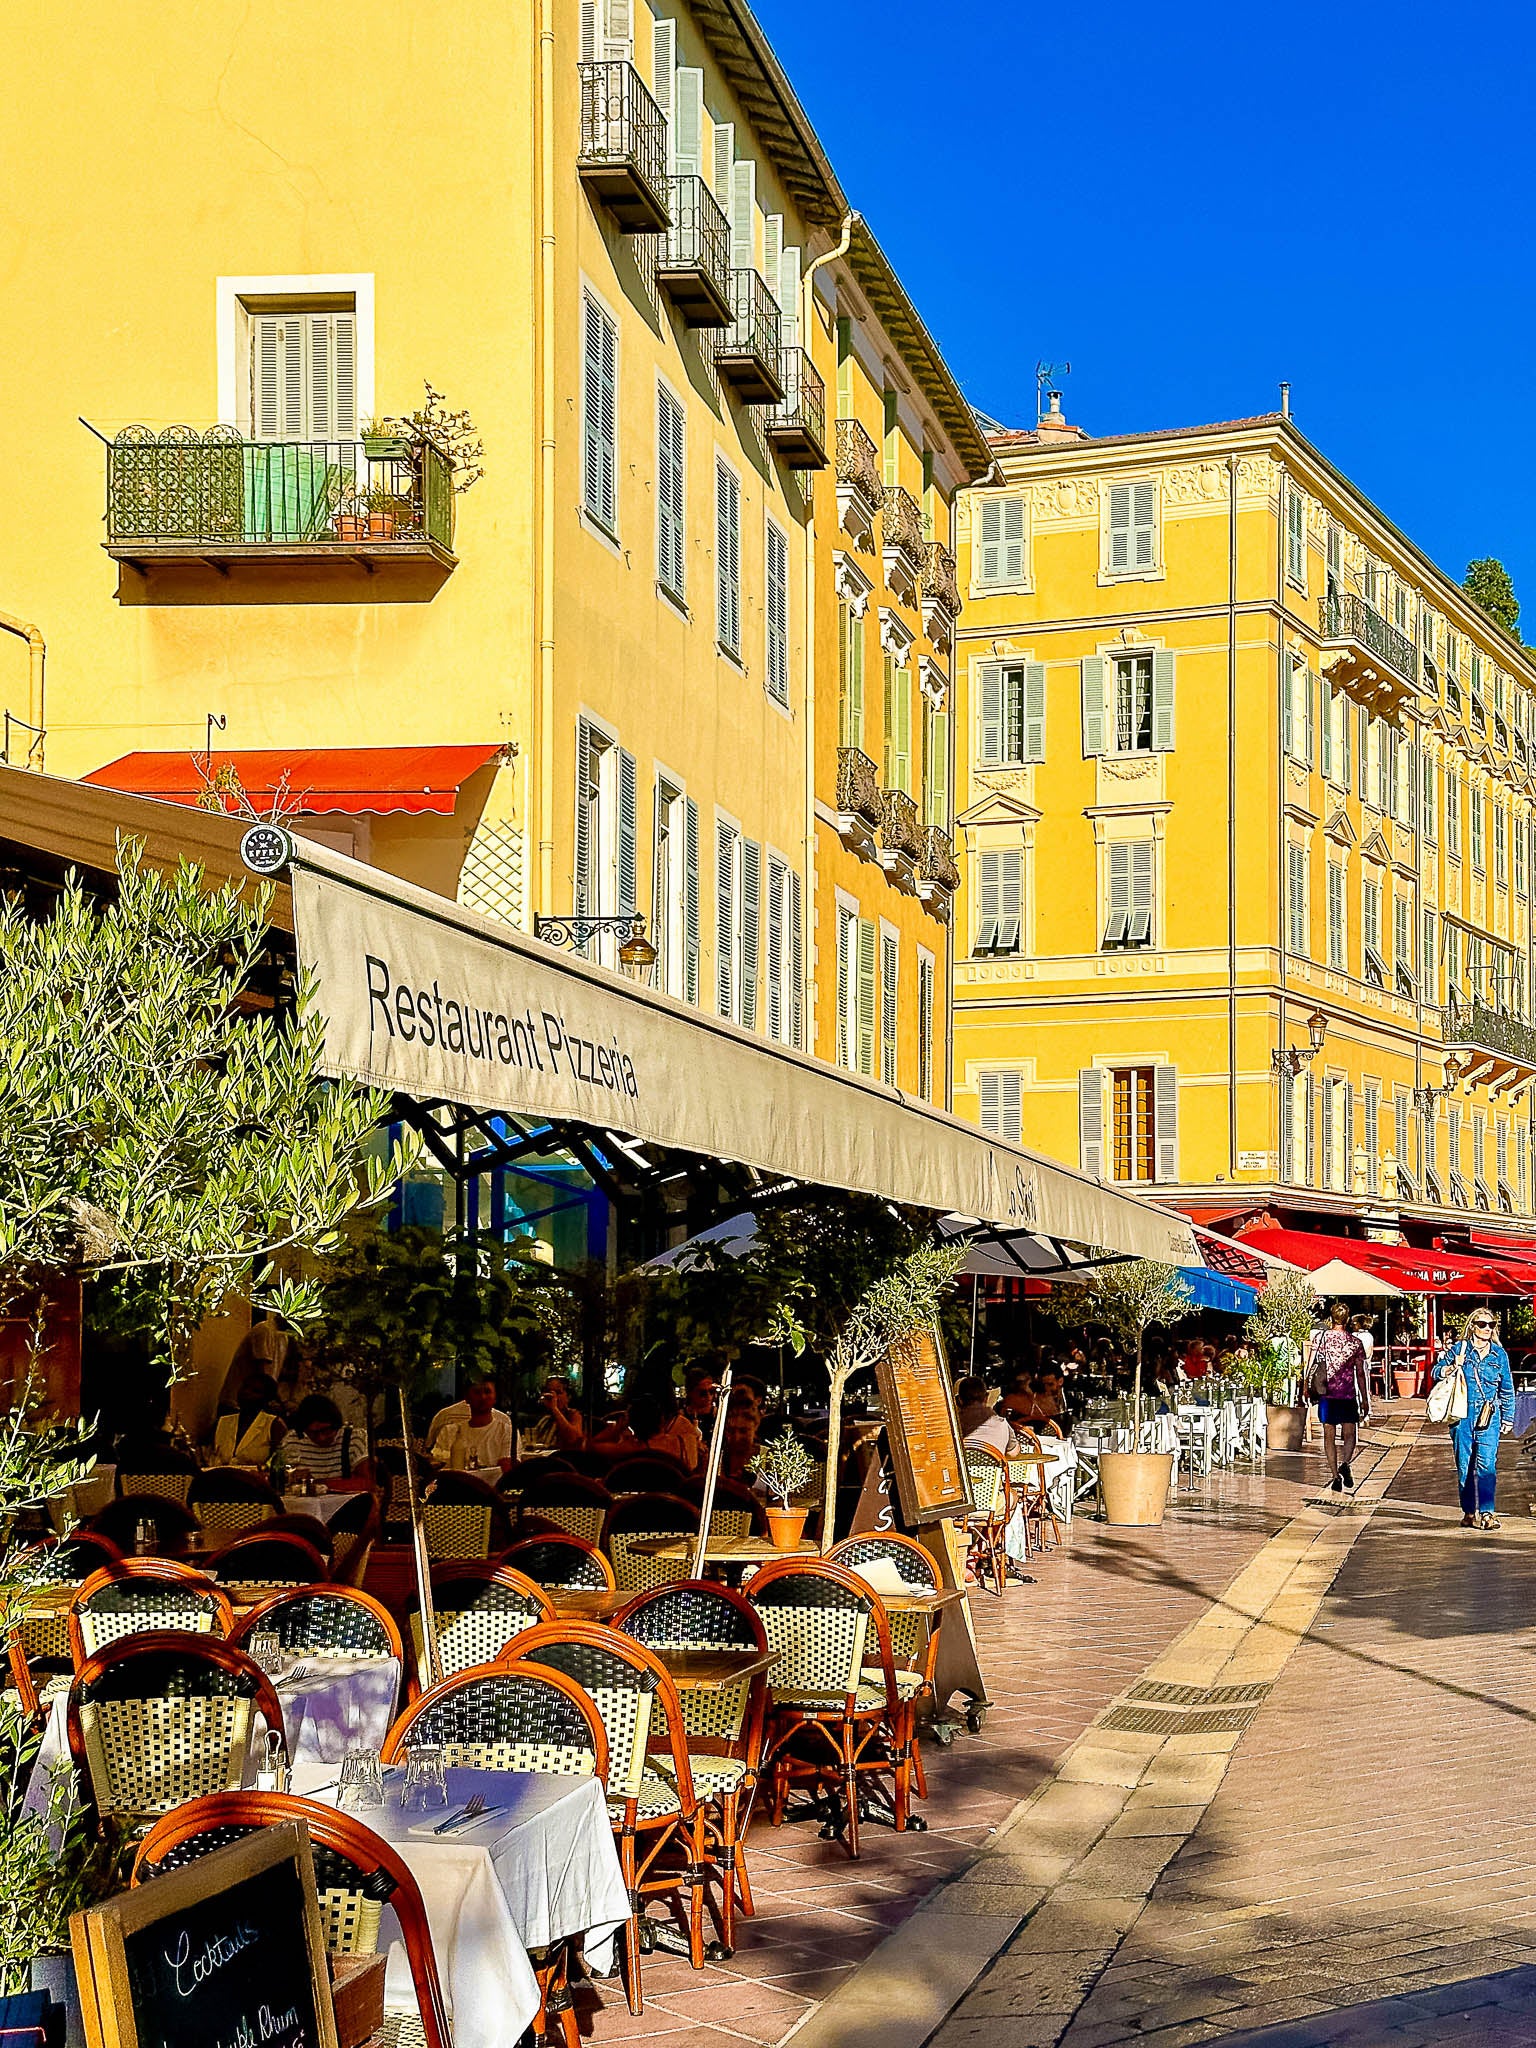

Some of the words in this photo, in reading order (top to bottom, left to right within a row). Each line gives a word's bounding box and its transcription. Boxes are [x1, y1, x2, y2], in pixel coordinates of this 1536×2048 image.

[247, 832, 281, 848] STORE
[365, 954, 544, 1072] Restaurant
[541, 1010, 639, 1099] Pizzeria
[1432, 1270, 1448, 1281] MIA
